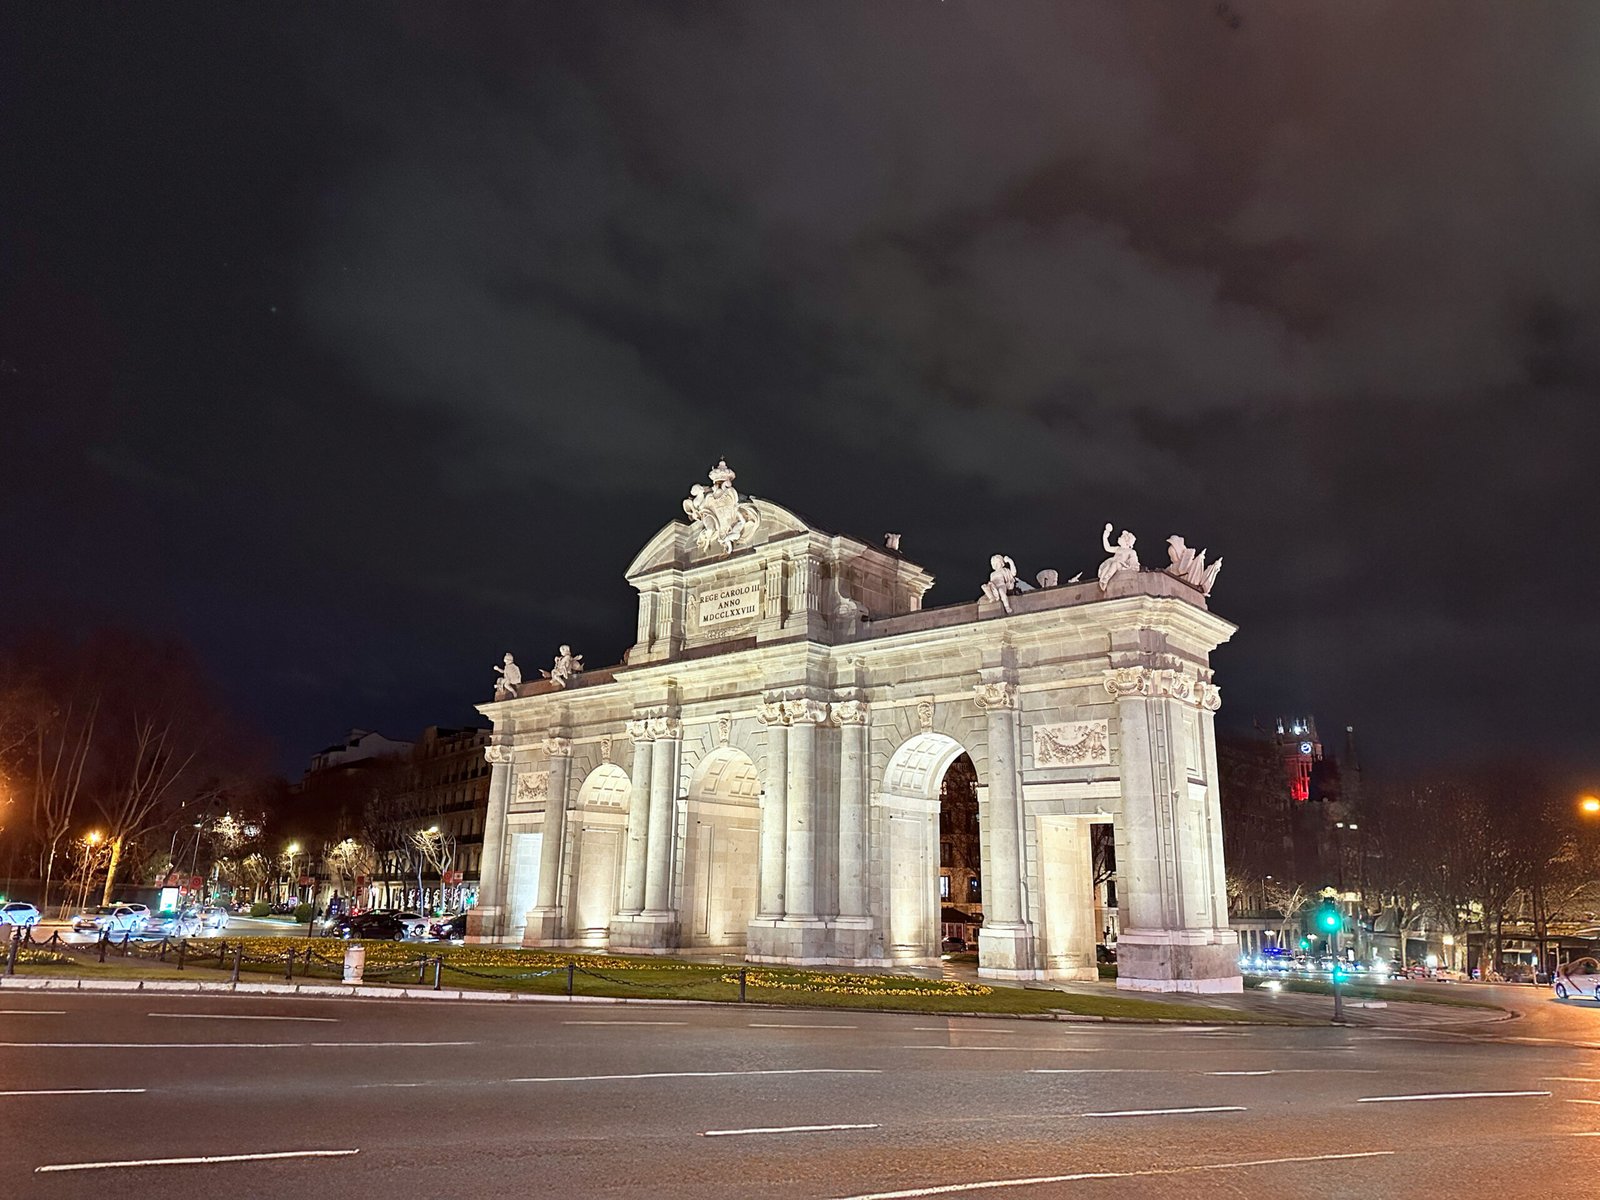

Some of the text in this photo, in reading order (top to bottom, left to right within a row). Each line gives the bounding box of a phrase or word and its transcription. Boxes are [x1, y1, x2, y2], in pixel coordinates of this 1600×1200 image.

[700, 594, 718, 603] REGE
[720, 587, 749, 599] CAROLO
[718, 599, 740, 609] ANNO
[703, 606, 755, 622] MDCCLXXVIII
